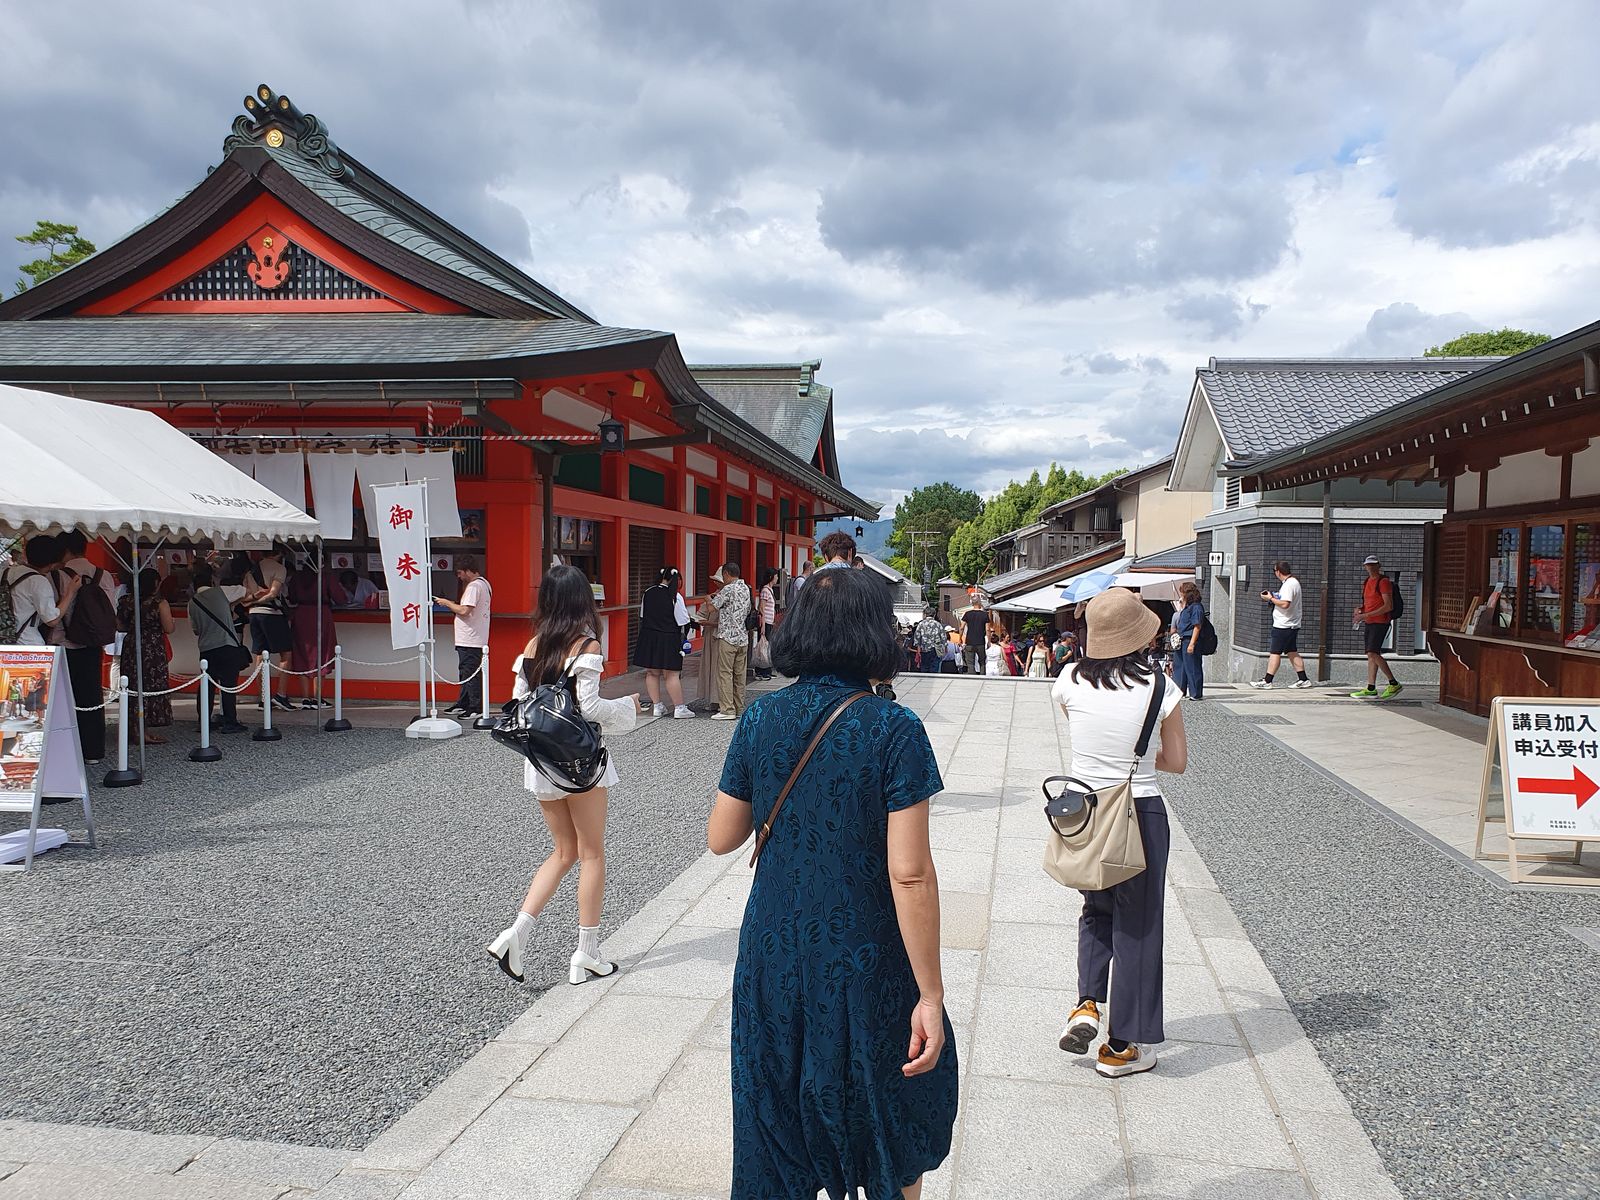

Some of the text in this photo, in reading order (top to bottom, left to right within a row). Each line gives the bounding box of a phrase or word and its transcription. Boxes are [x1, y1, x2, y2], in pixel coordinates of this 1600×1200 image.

[389, 504, 421, 629] 御朱印
[1511, 713, 1597, 733] 講員加入
[1514, 738, 1599, 759] 申込受付
